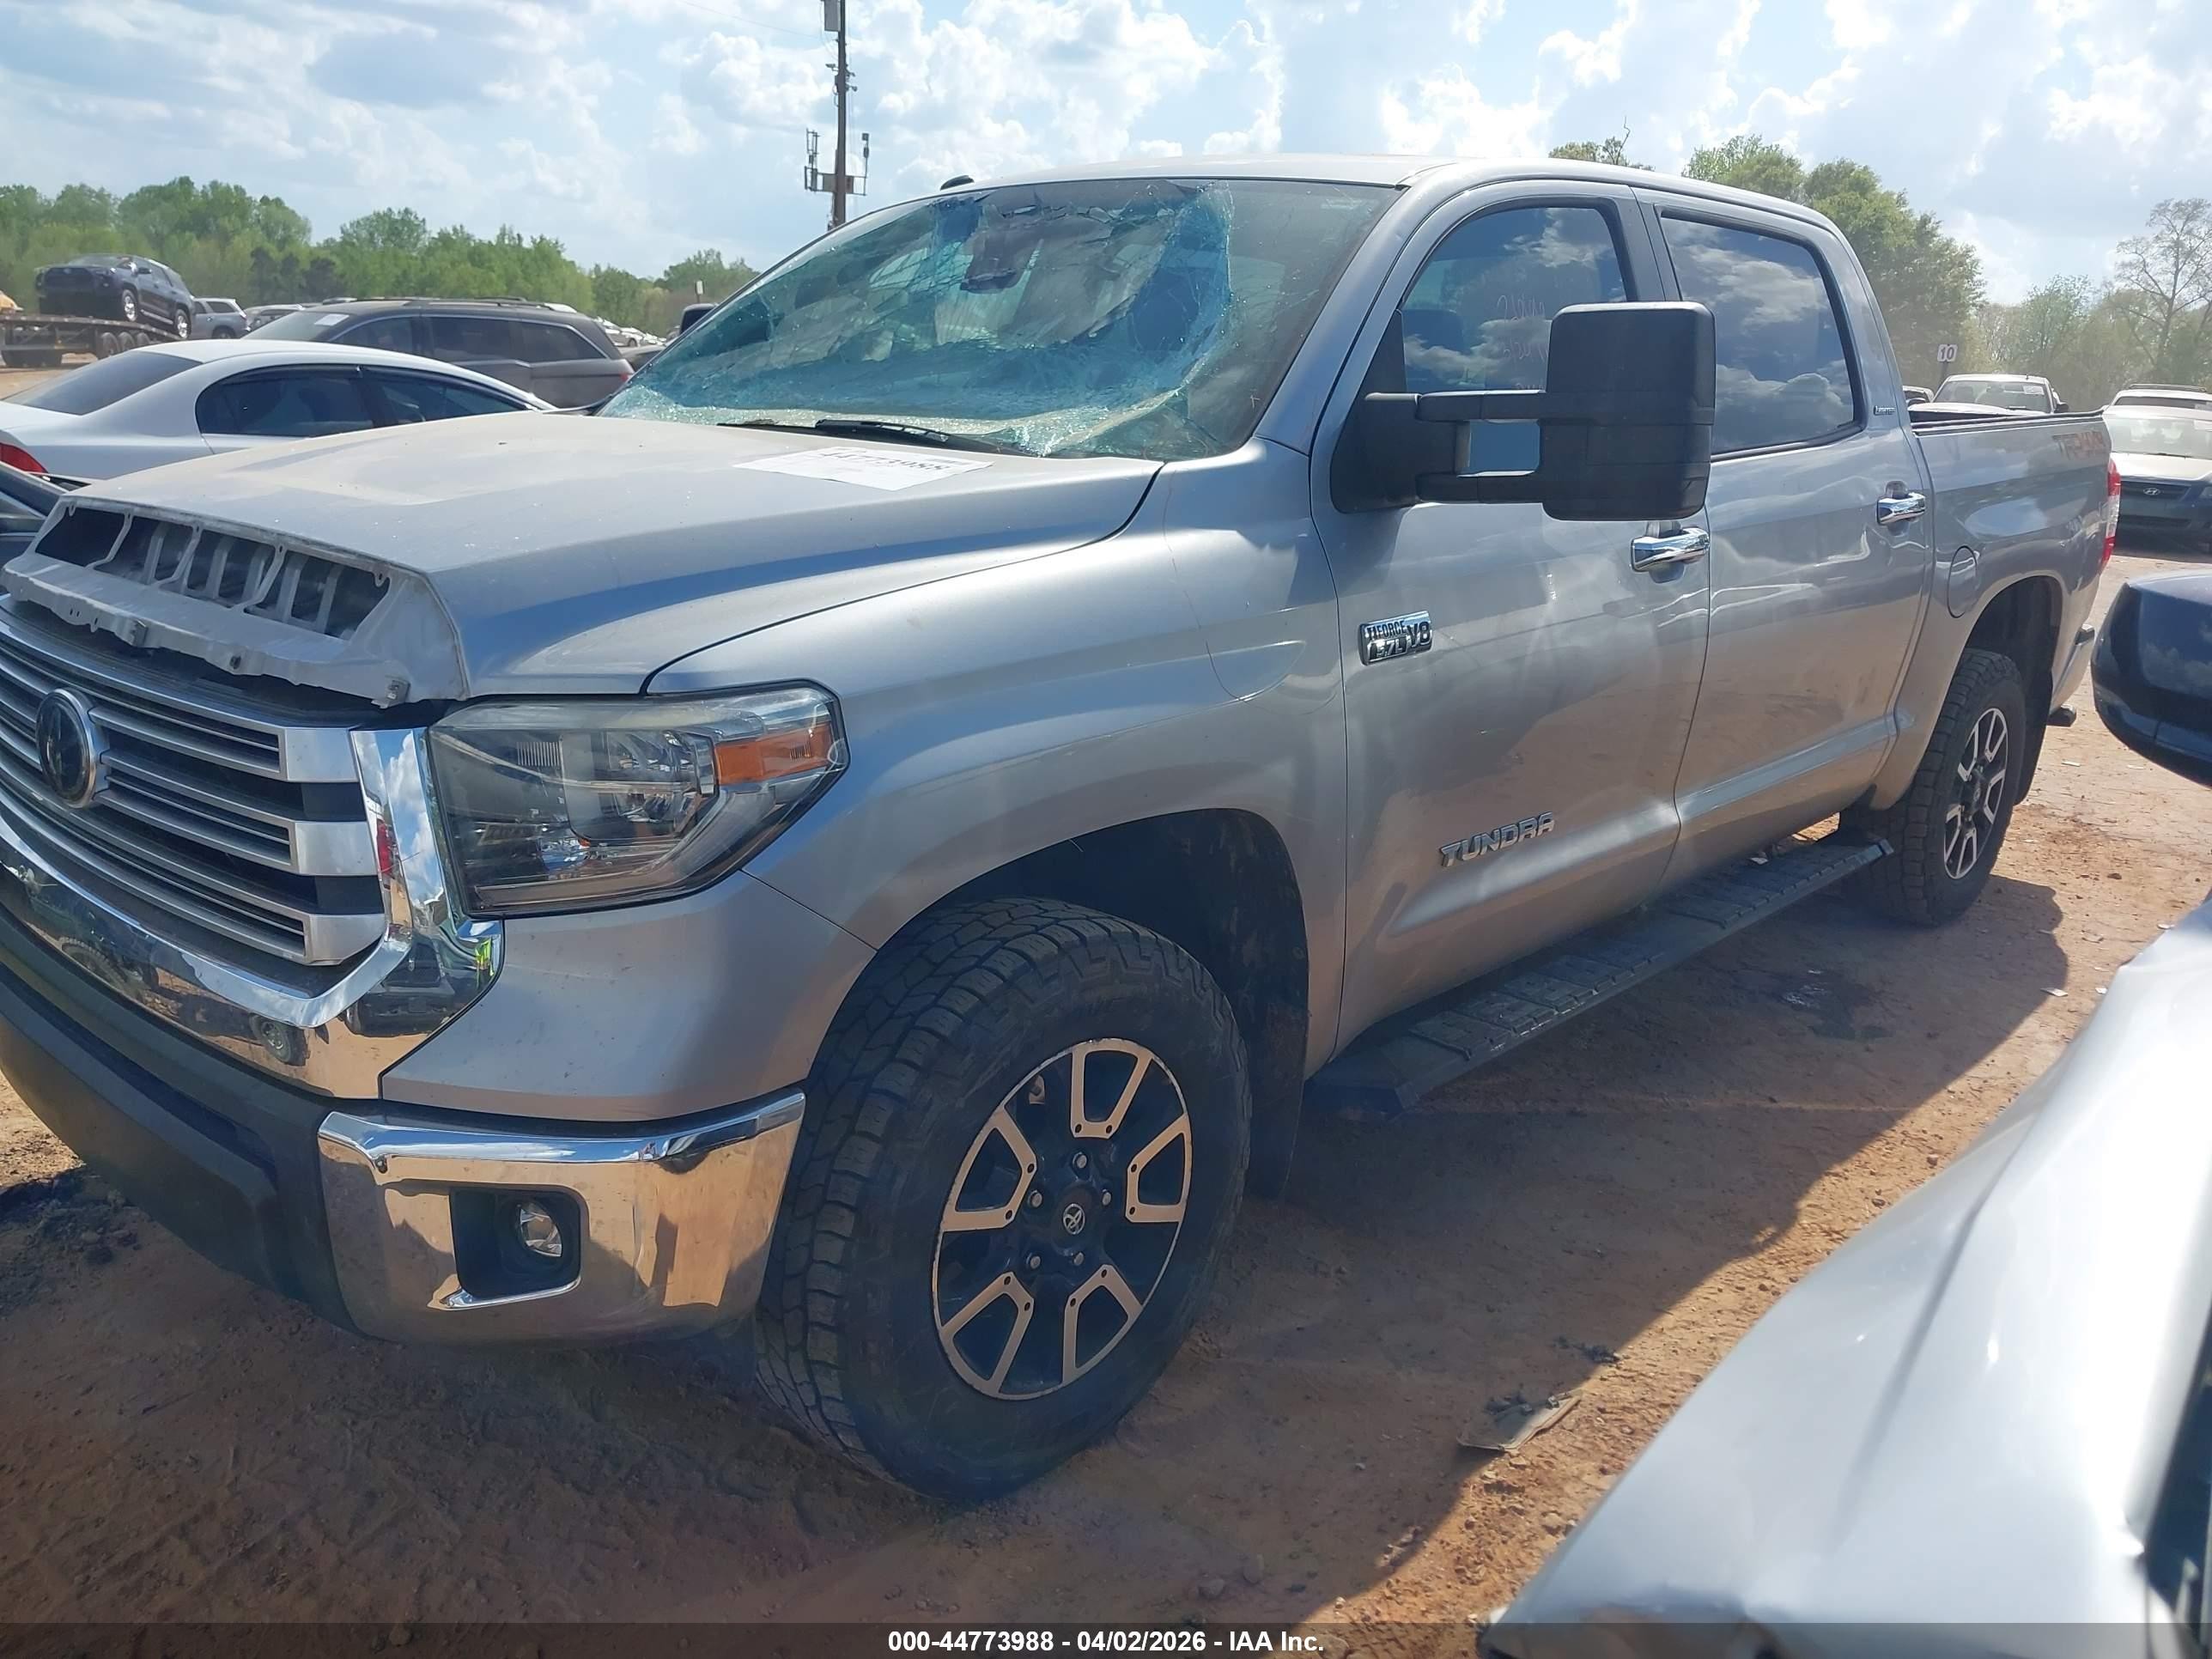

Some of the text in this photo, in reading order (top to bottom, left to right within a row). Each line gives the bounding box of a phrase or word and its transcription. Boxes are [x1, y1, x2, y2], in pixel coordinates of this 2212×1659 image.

[1941, 346, 1955, 361] 10
[1407, 620, 1431, 647] V8
[1439, 811, 1555, 867] TUNDRA
